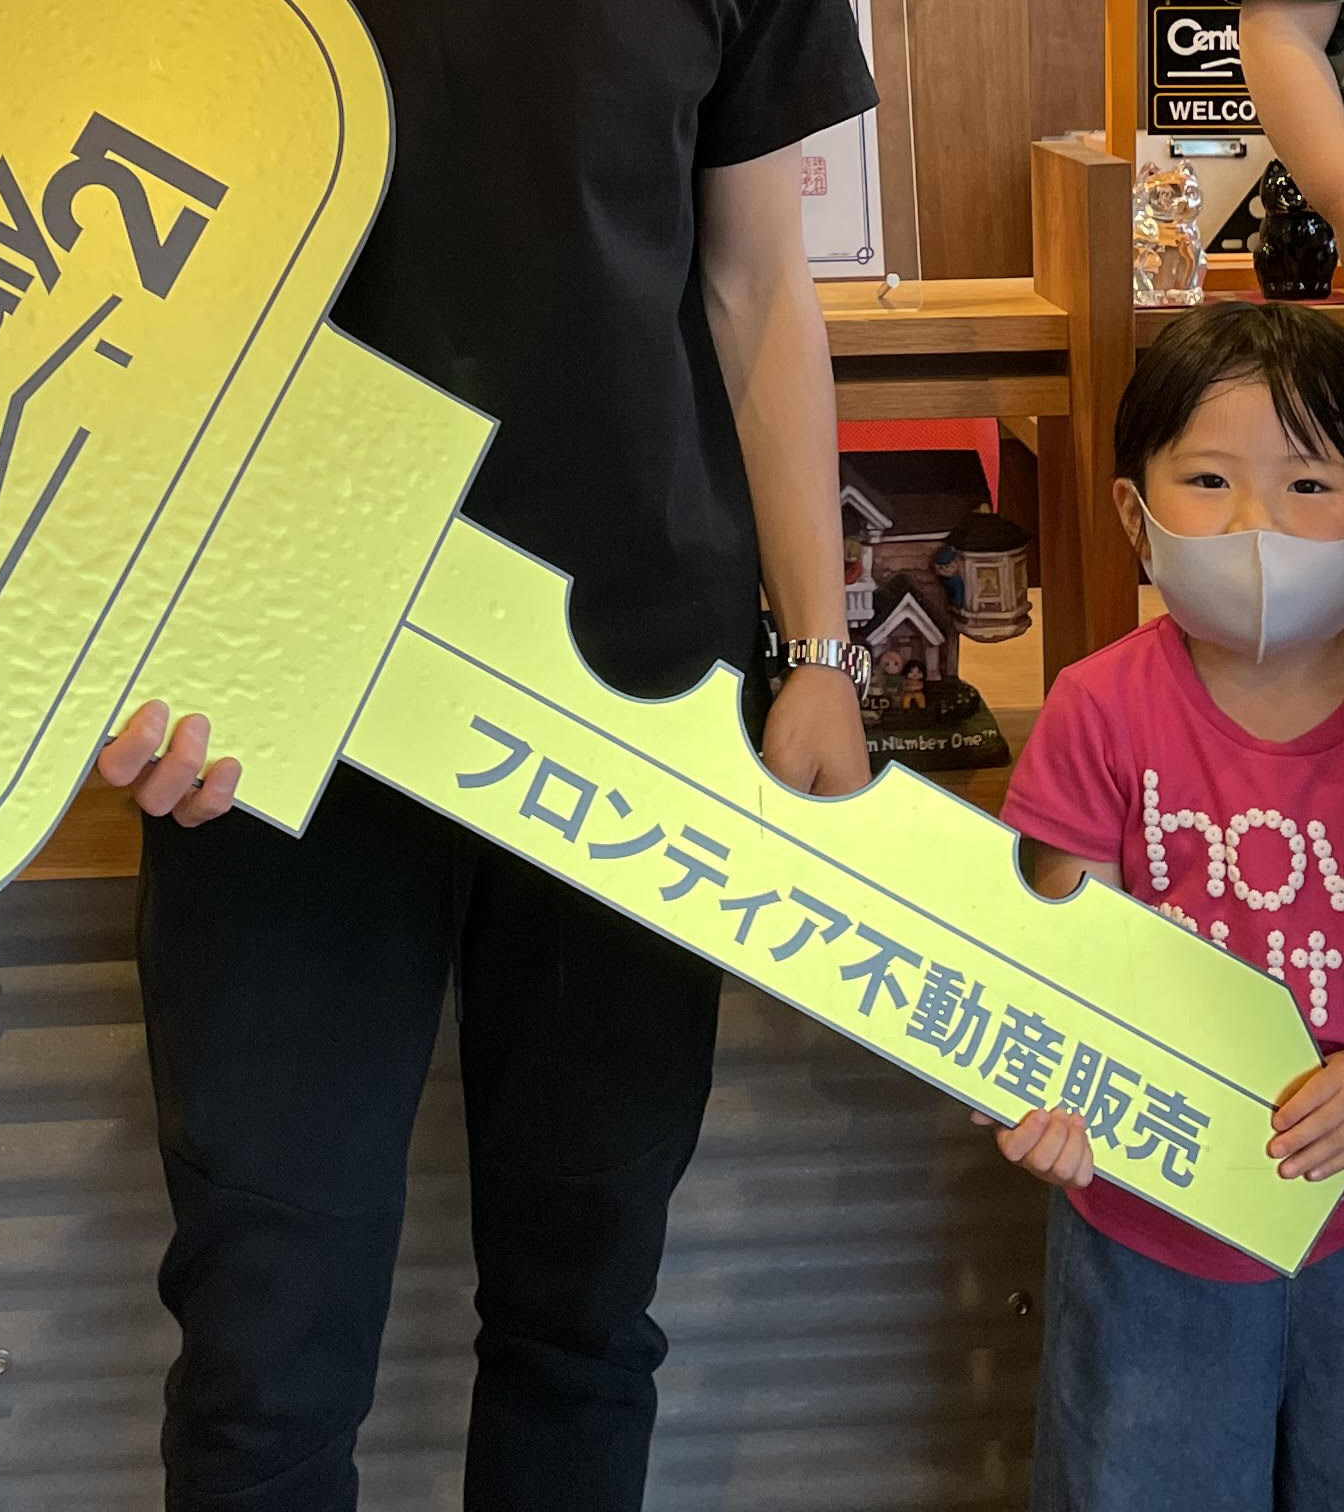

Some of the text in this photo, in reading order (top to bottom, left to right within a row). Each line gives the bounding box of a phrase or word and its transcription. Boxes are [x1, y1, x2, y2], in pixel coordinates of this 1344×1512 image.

[42, 111, 230, 300] 21
[882, 734, 949, 752] Number
[455, 715, 1212, 1189] フロンティア不動産販売
